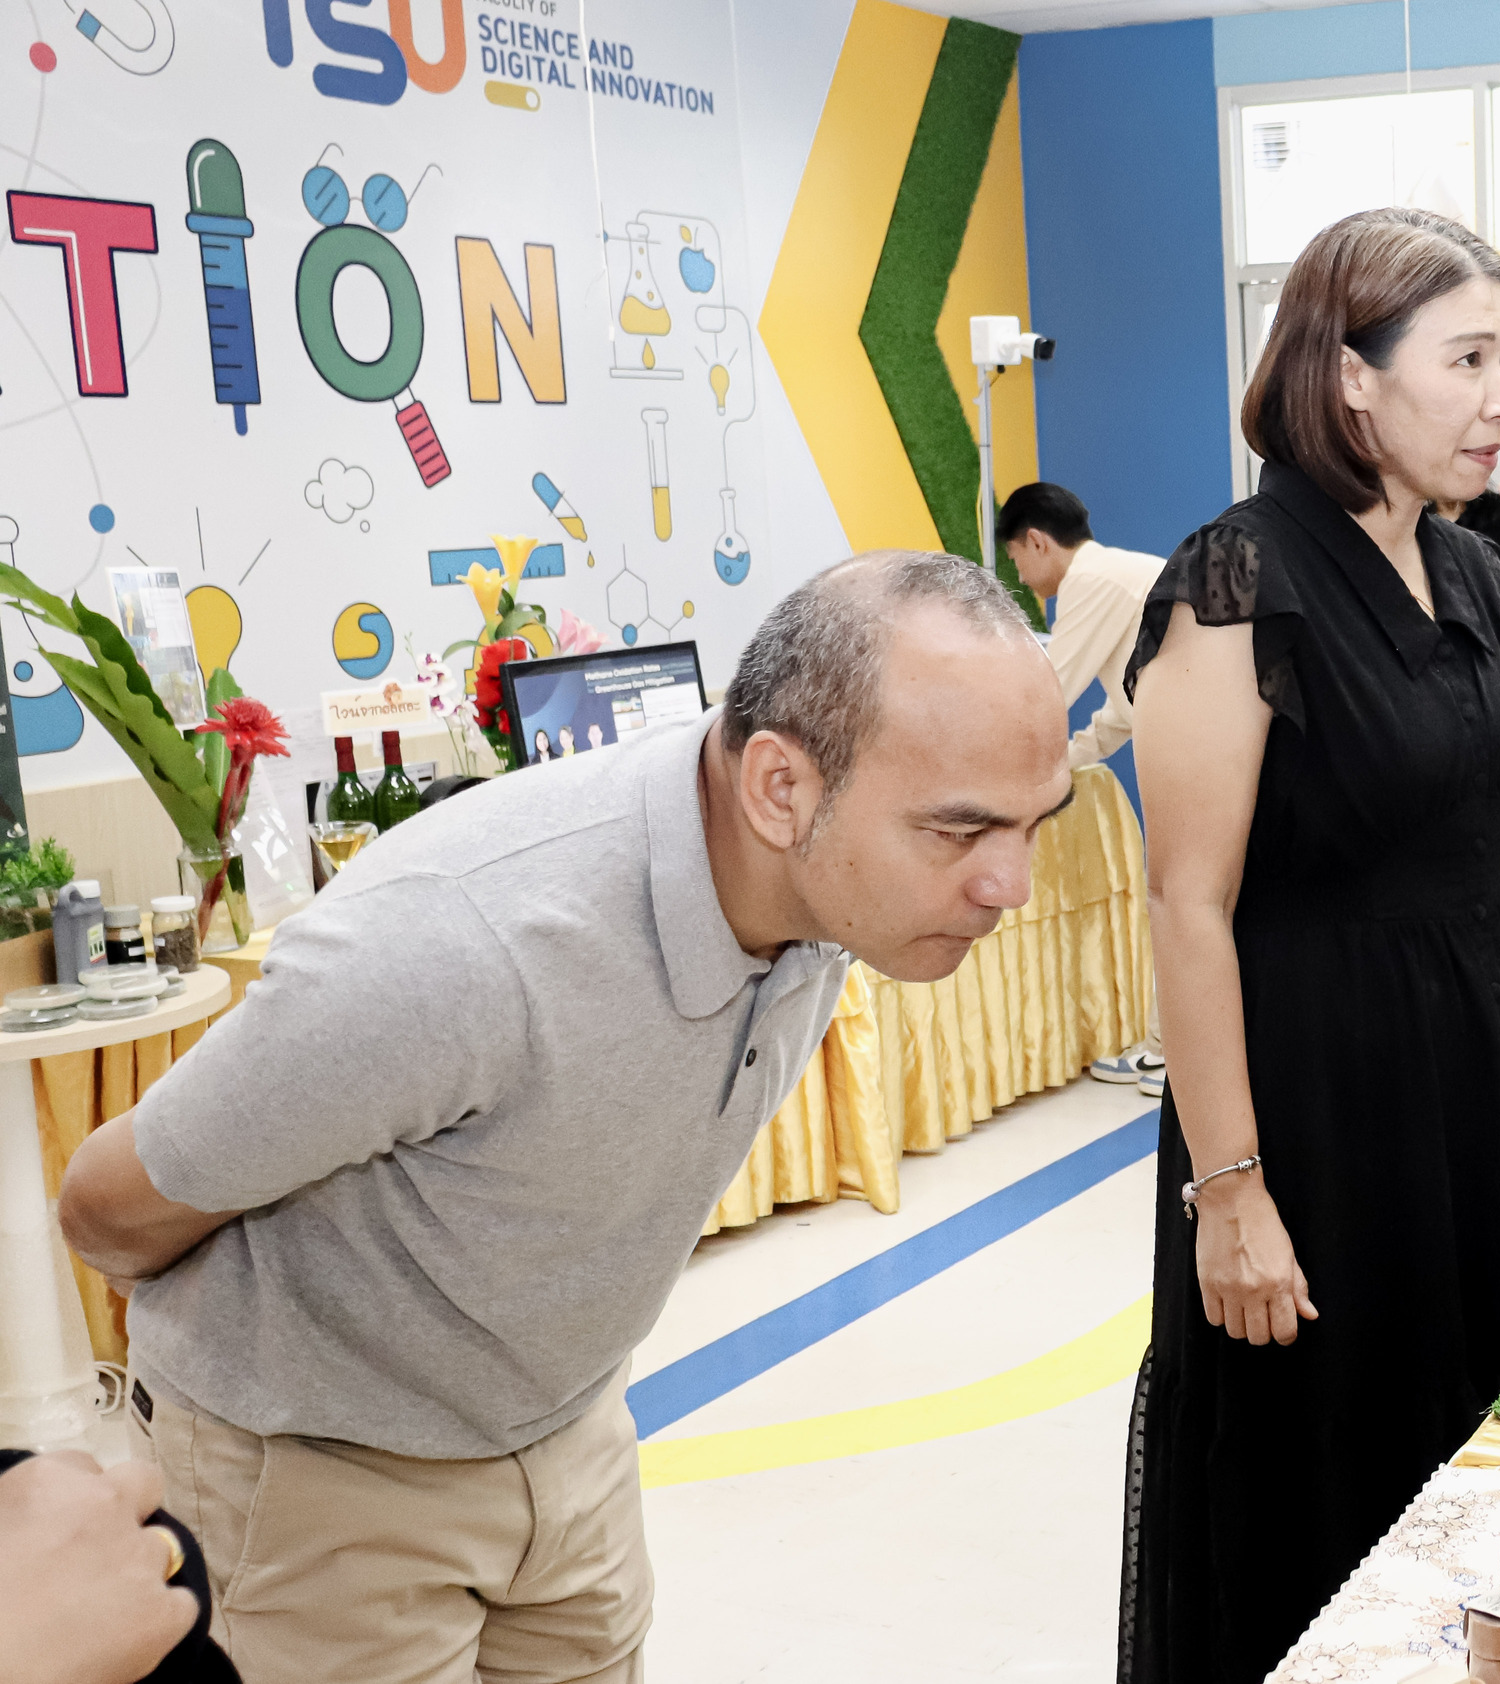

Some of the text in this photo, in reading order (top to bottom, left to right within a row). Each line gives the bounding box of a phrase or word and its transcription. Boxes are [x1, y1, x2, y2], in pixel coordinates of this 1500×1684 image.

[540, 0, 557, 17] OF
[478, 13, 634, 71] SCIENCE AND
[481, 46, 715, 116] DIGITAL INNOVATION
